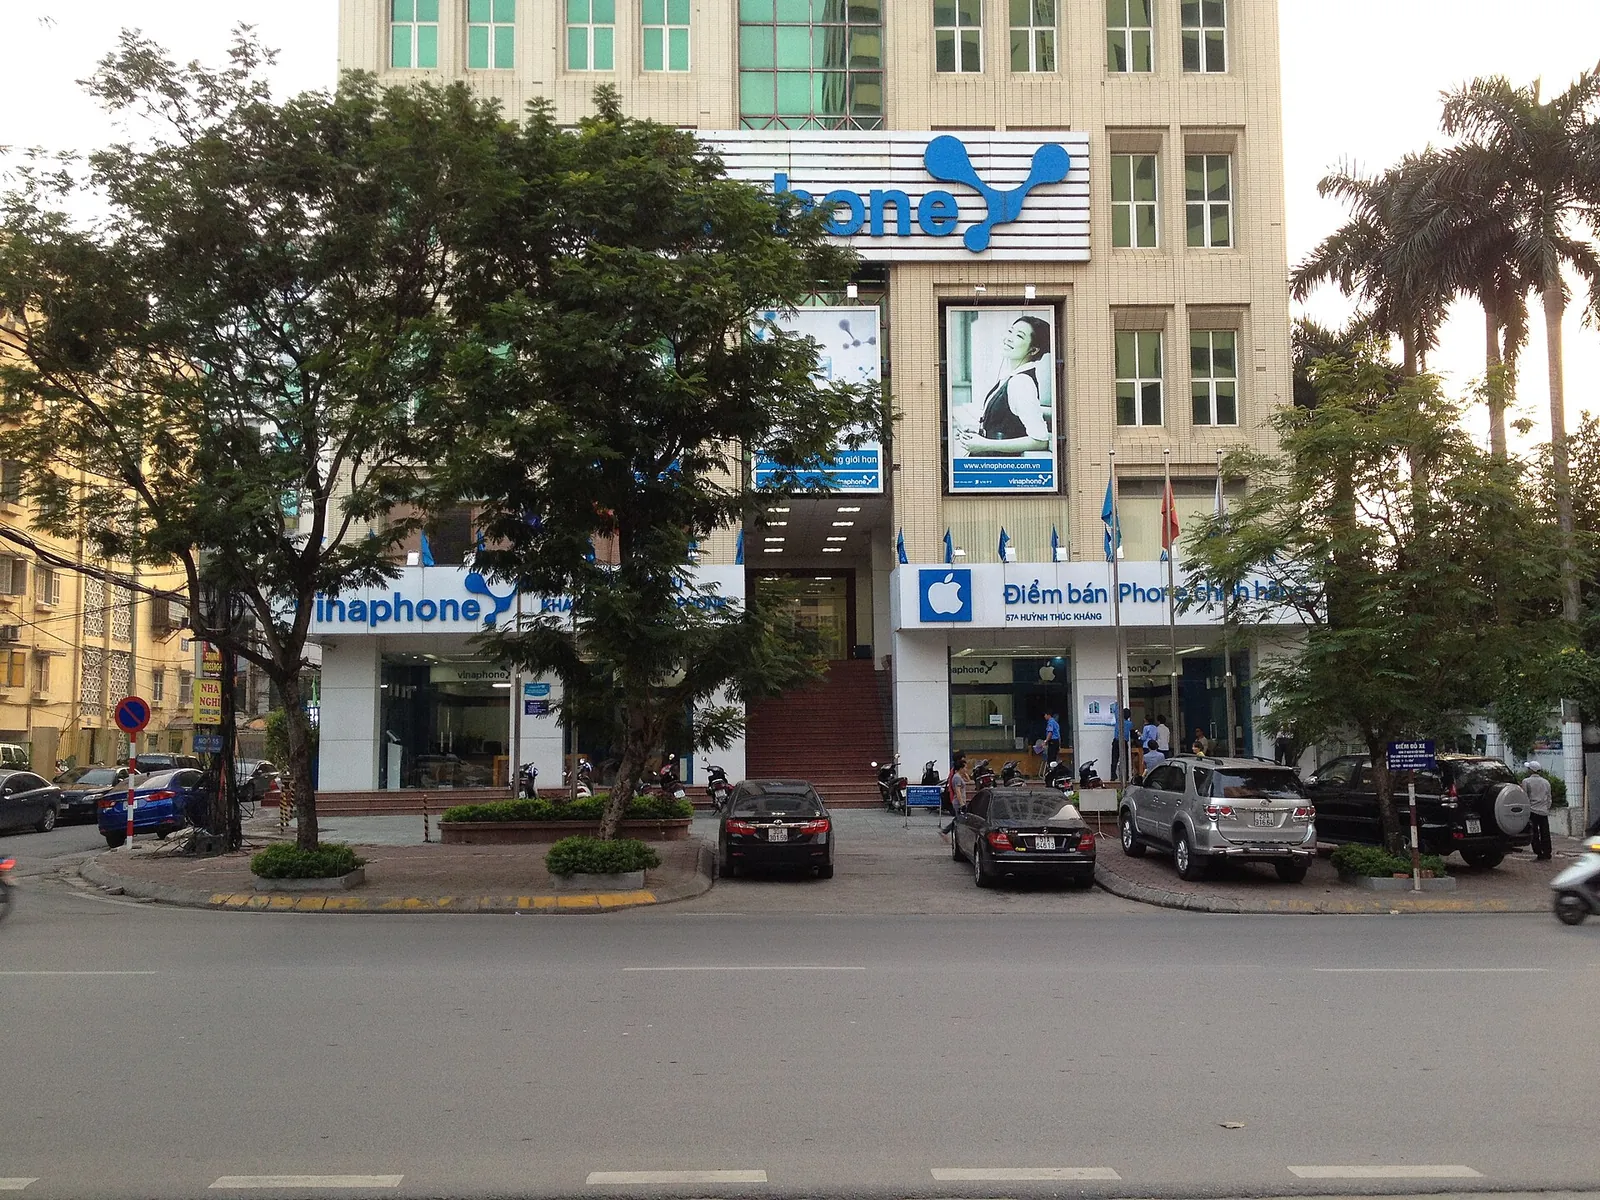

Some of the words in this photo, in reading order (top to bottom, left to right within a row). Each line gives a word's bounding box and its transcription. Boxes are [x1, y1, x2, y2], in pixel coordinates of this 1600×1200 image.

[963, 462, 1041, 471] www.vinaphone.com.vn
[1008, 477, 1043, 486] vinaphone
[1003, 579, 1063, 605] Điểm
[1067, 582, 1108, 604] bán
[315, 592, 481, 627] inaphone
[1073, 611, 1102, 621] KHÁNG
[457, 670, 506, 680] vinaphone
[950, 665, 985, 675] aphone
